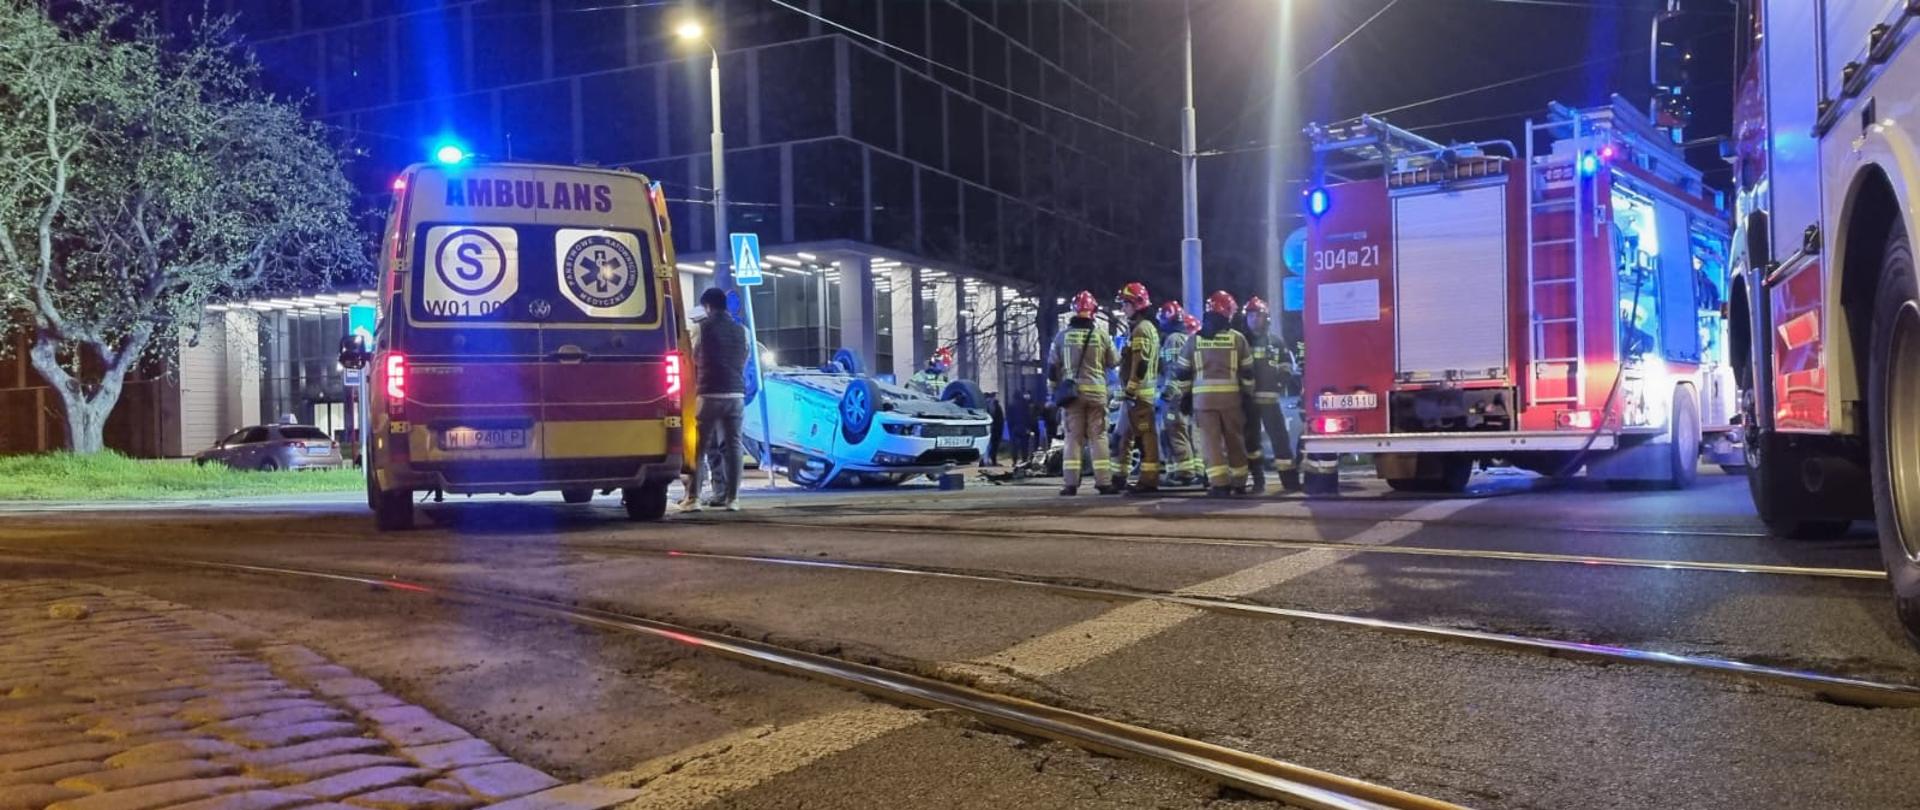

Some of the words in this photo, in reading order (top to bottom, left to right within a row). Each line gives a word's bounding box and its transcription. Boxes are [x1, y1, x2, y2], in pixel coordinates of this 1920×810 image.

[446, 178, 612, 212] AMBULANS
[456, 243, 484, 281] S
[1313, 248, 1346, 271] 304
[1360, 245, 1379, 267] 21
[426, 299, 470, 316] W01
[1321, 396, 1334, 408] WI
[449, 432, 466, 447] WI
